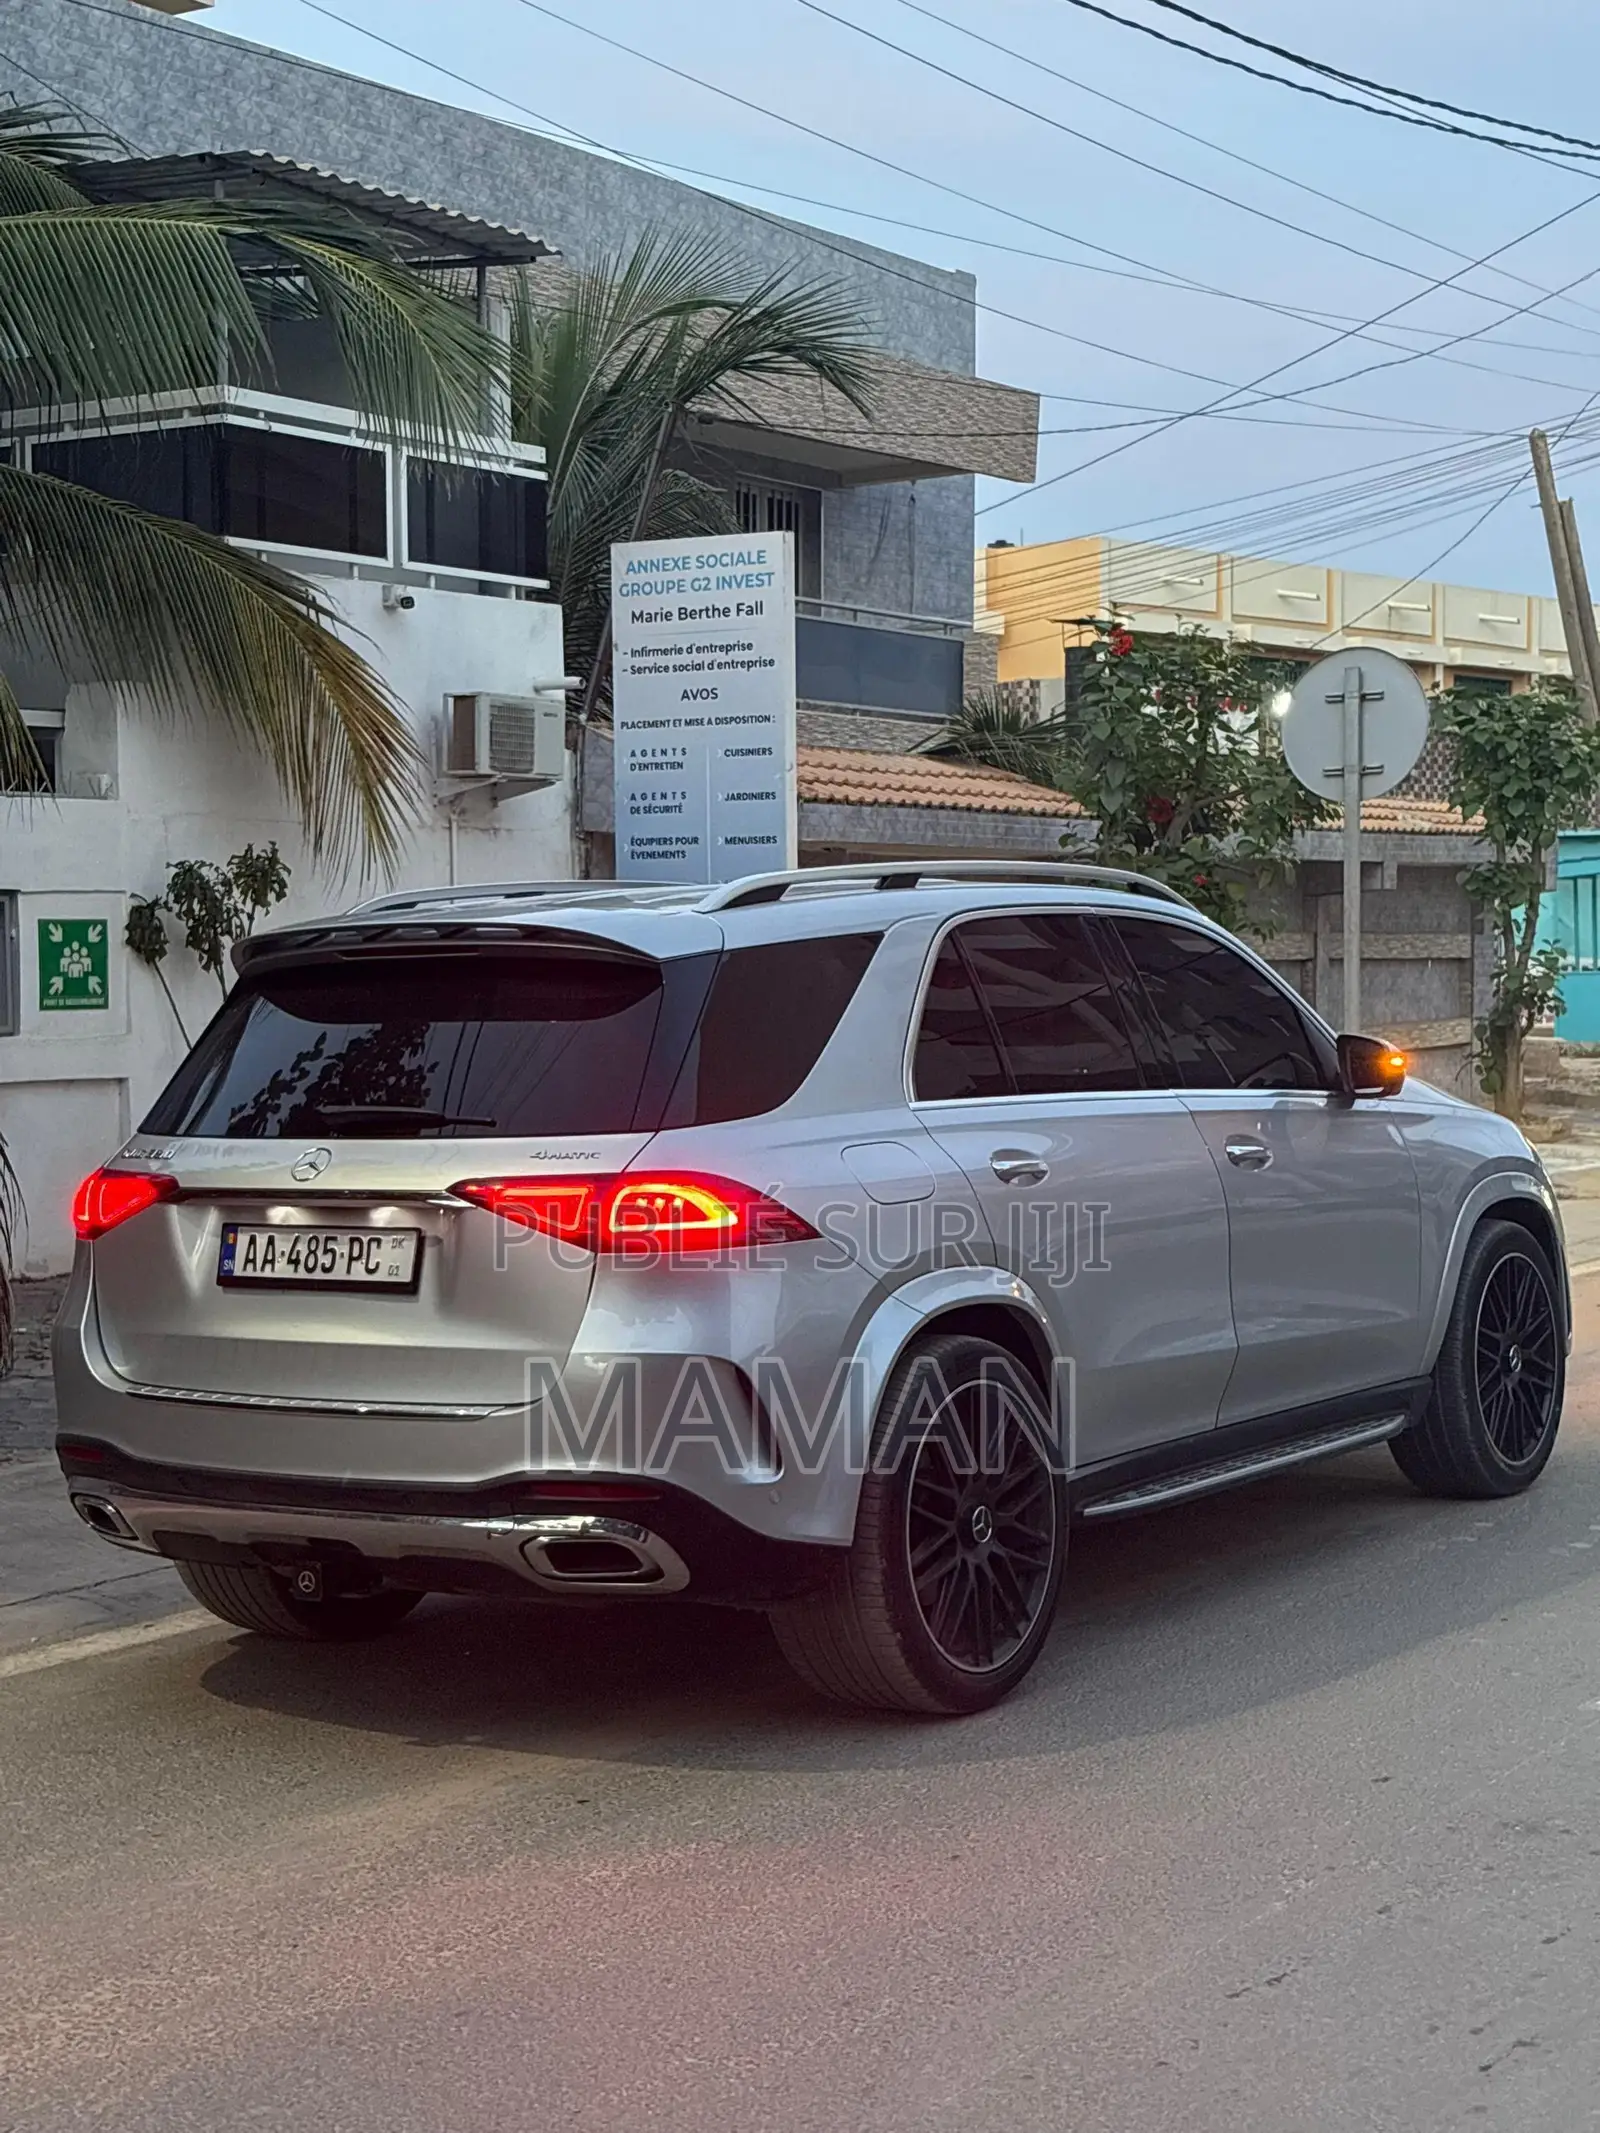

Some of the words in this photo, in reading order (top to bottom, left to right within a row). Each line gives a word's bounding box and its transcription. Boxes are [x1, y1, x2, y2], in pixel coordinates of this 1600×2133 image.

[625, 556, 692, 576] ANNEXE
[695, 550, 767, 570] SOCIALE
[619, 578, 687, 598] GROUPE
[690, 577, 712, 593] G2
[716, 572, 775, 591] INVEST
[631, 606, 674, 625] Marie
[677, 604, 732, 622] Berthe
[736, 600, 764, 617] Fall
[630, 644, 684, 658] Infirmerie
[686, 640, 754, 655] d'entreprise
[630, 662, 670, 675] Service
[672, 660, 705, 673] social
[707, 656, 775, 672] d'entreprise
[680, 688, 719, 701] AVOS
[620, 719, 671, 730] PLACEMENT
[672, 718, 682, 728] ET
[684, 717, 705, 727] MISE
[723, 747, 773, 758] CUISINIERS
[629, 761, 684, 772] D'ENTRETIEN
[724, 791, 777, 801] JARDINIERS
[629, 805, 641, 815] DE
[643, 802, 683, 815] SÉCURITÉ
[675, 836, 699, 846] POUR
[724, 835, 778, 845] MENUISIERS
[223, 1258, 235, 1271] SN
